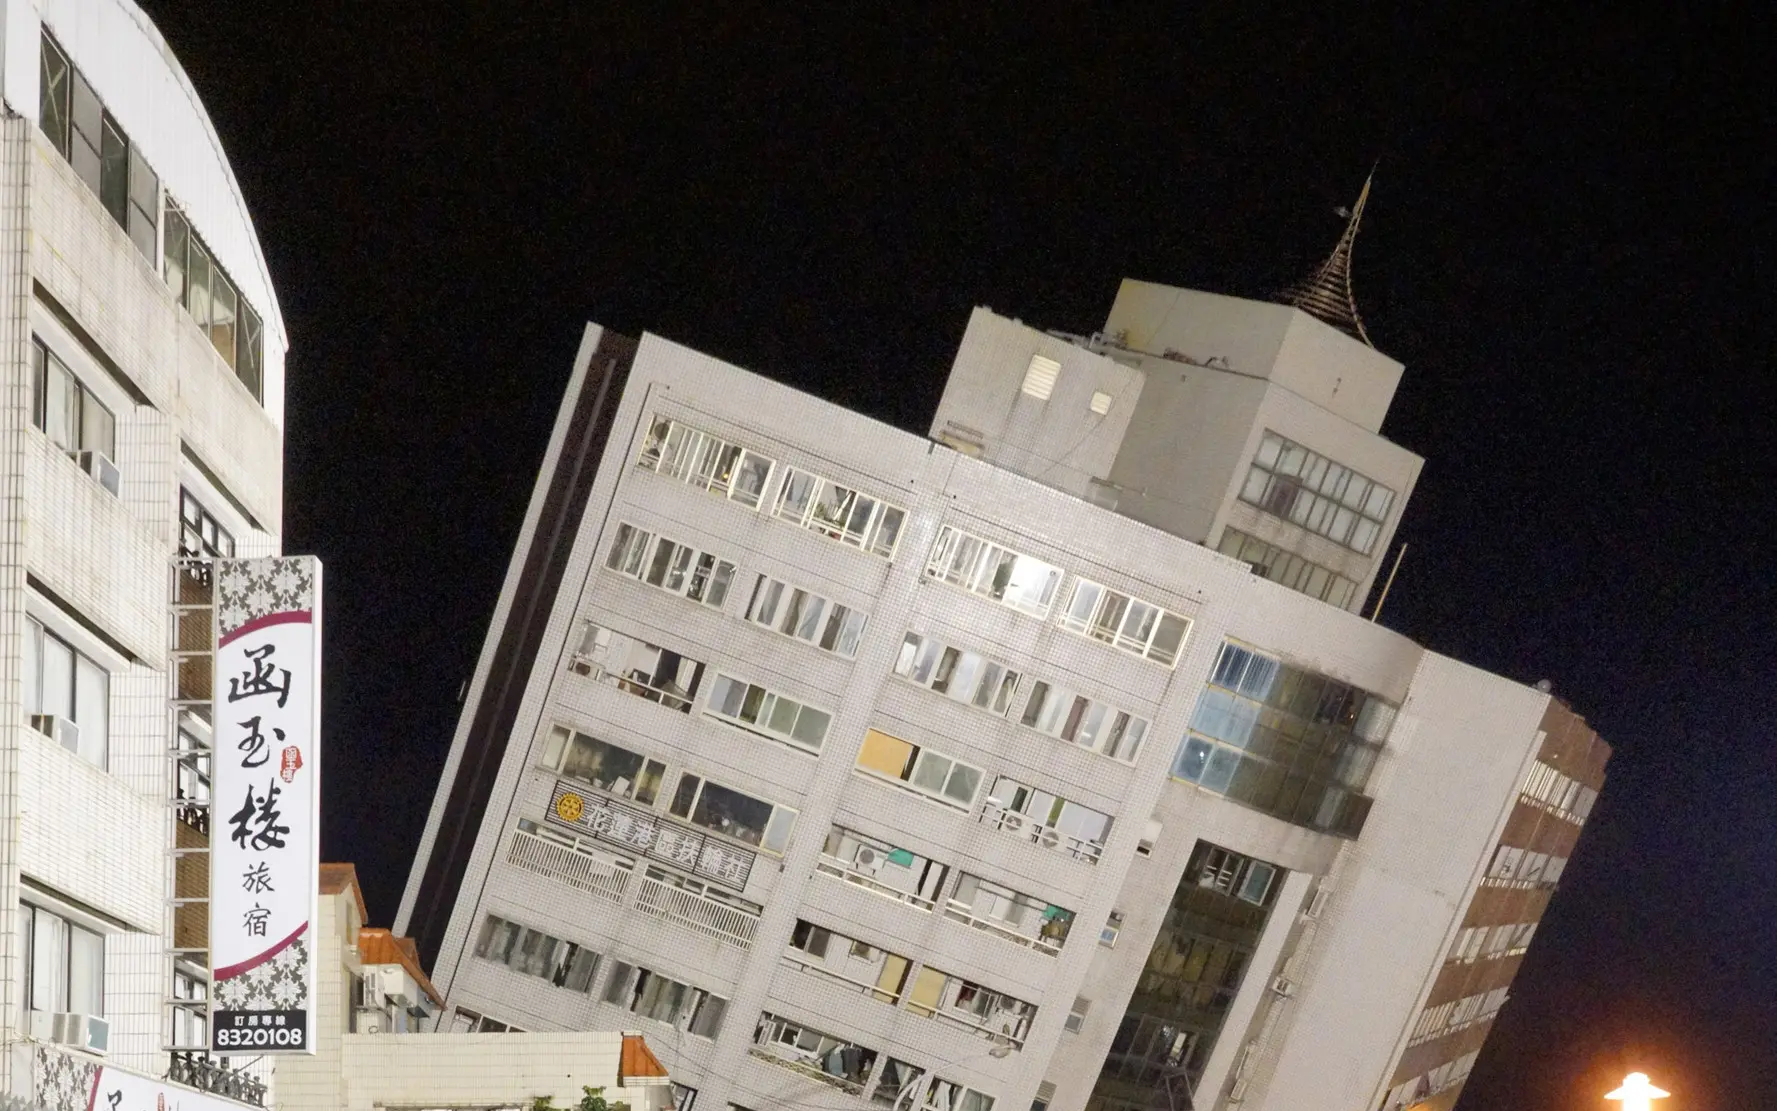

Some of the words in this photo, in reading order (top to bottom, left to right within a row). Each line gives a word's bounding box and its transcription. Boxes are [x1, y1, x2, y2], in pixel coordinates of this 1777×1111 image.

[587, 803, 749, 883] 花蓮港區扶輪社
[217, 1028, 303, 1046] 8320108
